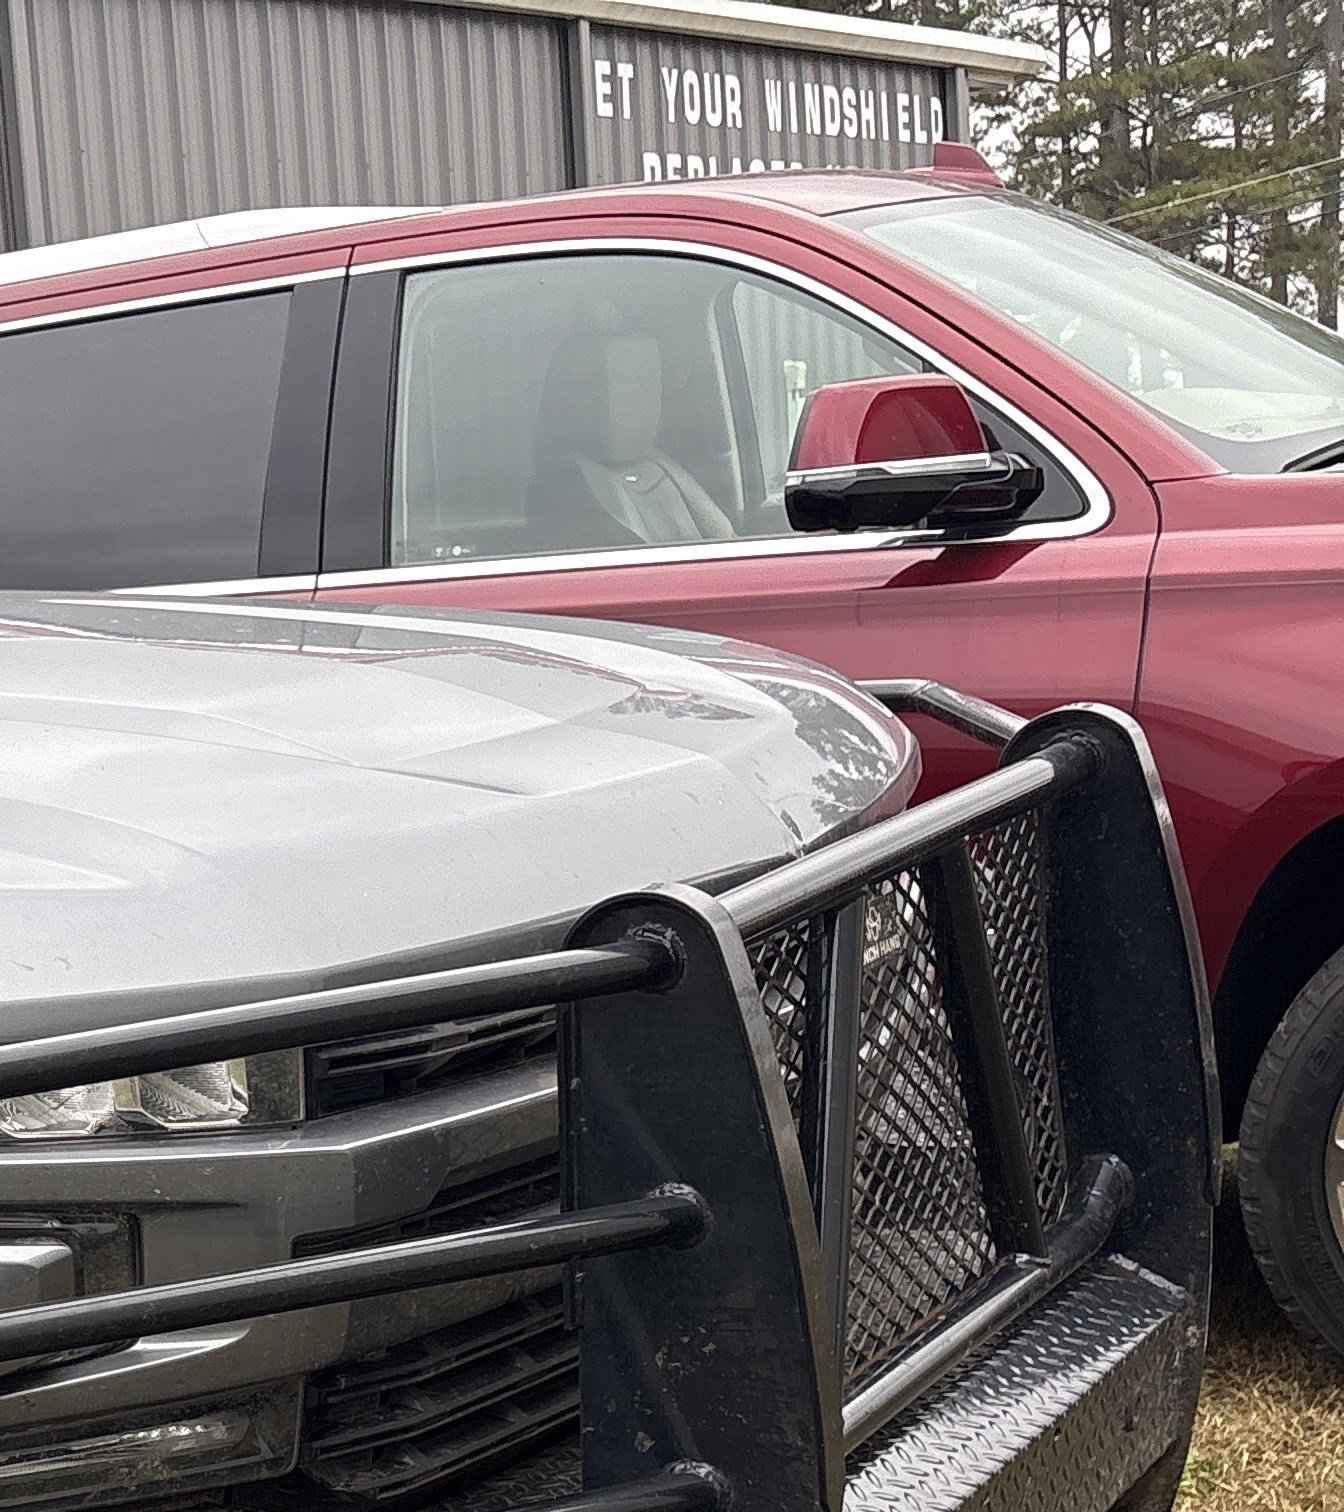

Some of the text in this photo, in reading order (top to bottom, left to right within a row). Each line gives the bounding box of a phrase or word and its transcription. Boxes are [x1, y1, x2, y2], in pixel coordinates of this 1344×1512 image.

[594, 59, 944, 145] ET YOUR WINDSHIELD
